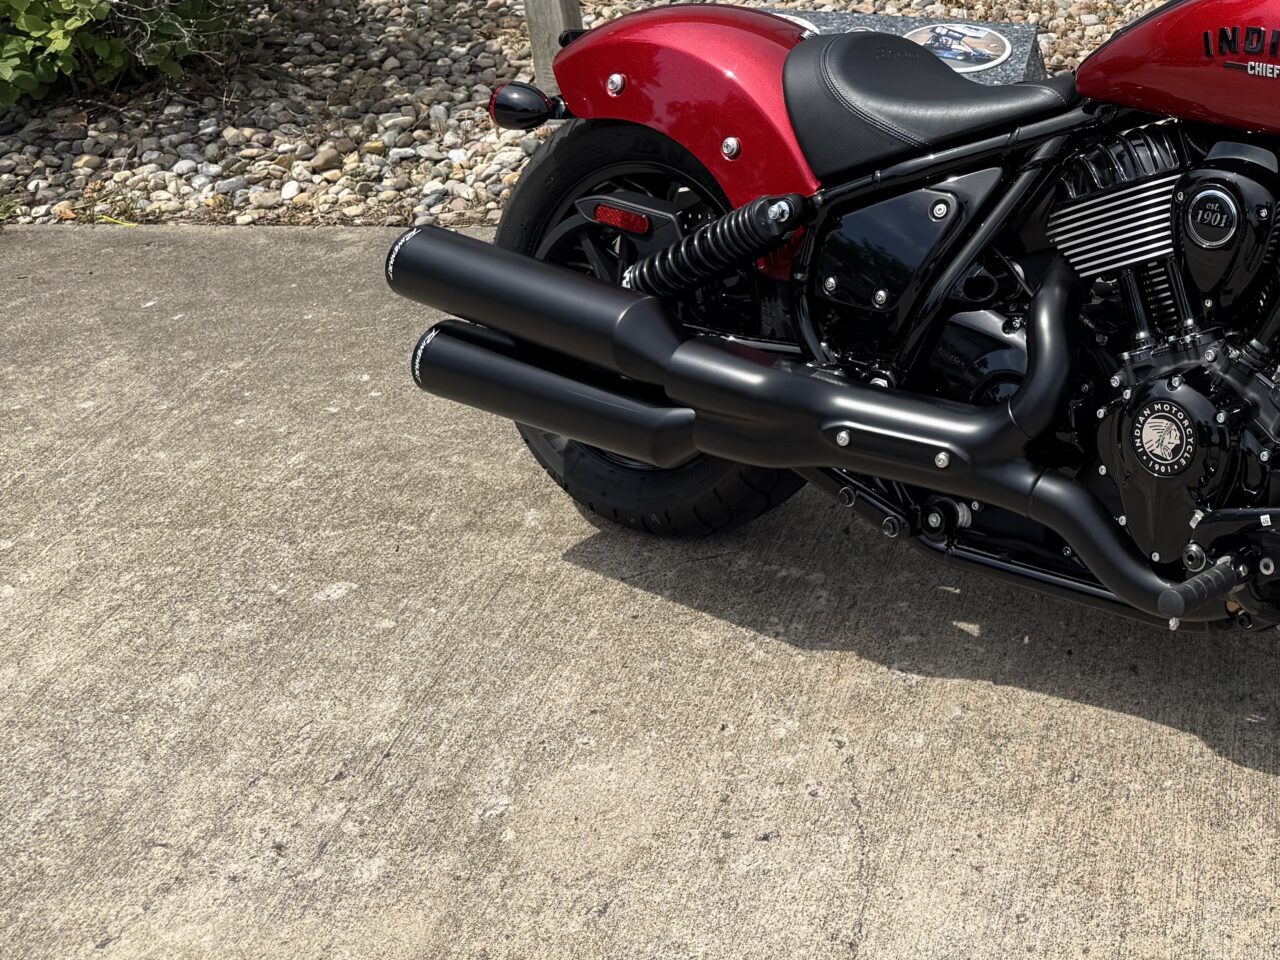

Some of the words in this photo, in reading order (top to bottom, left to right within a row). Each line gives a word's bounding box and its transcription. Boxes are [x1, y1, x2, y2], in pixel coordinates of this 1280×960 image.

[1247, 61, 1280, 78] CHIEF
[1196, 209, 1228, 227] 1901
[1134, 408, 1151, 452] INDIAN
[1154, 403, 1194, 466] MOTORCYCLE
[1148, 460, 1171, 473] 1901
